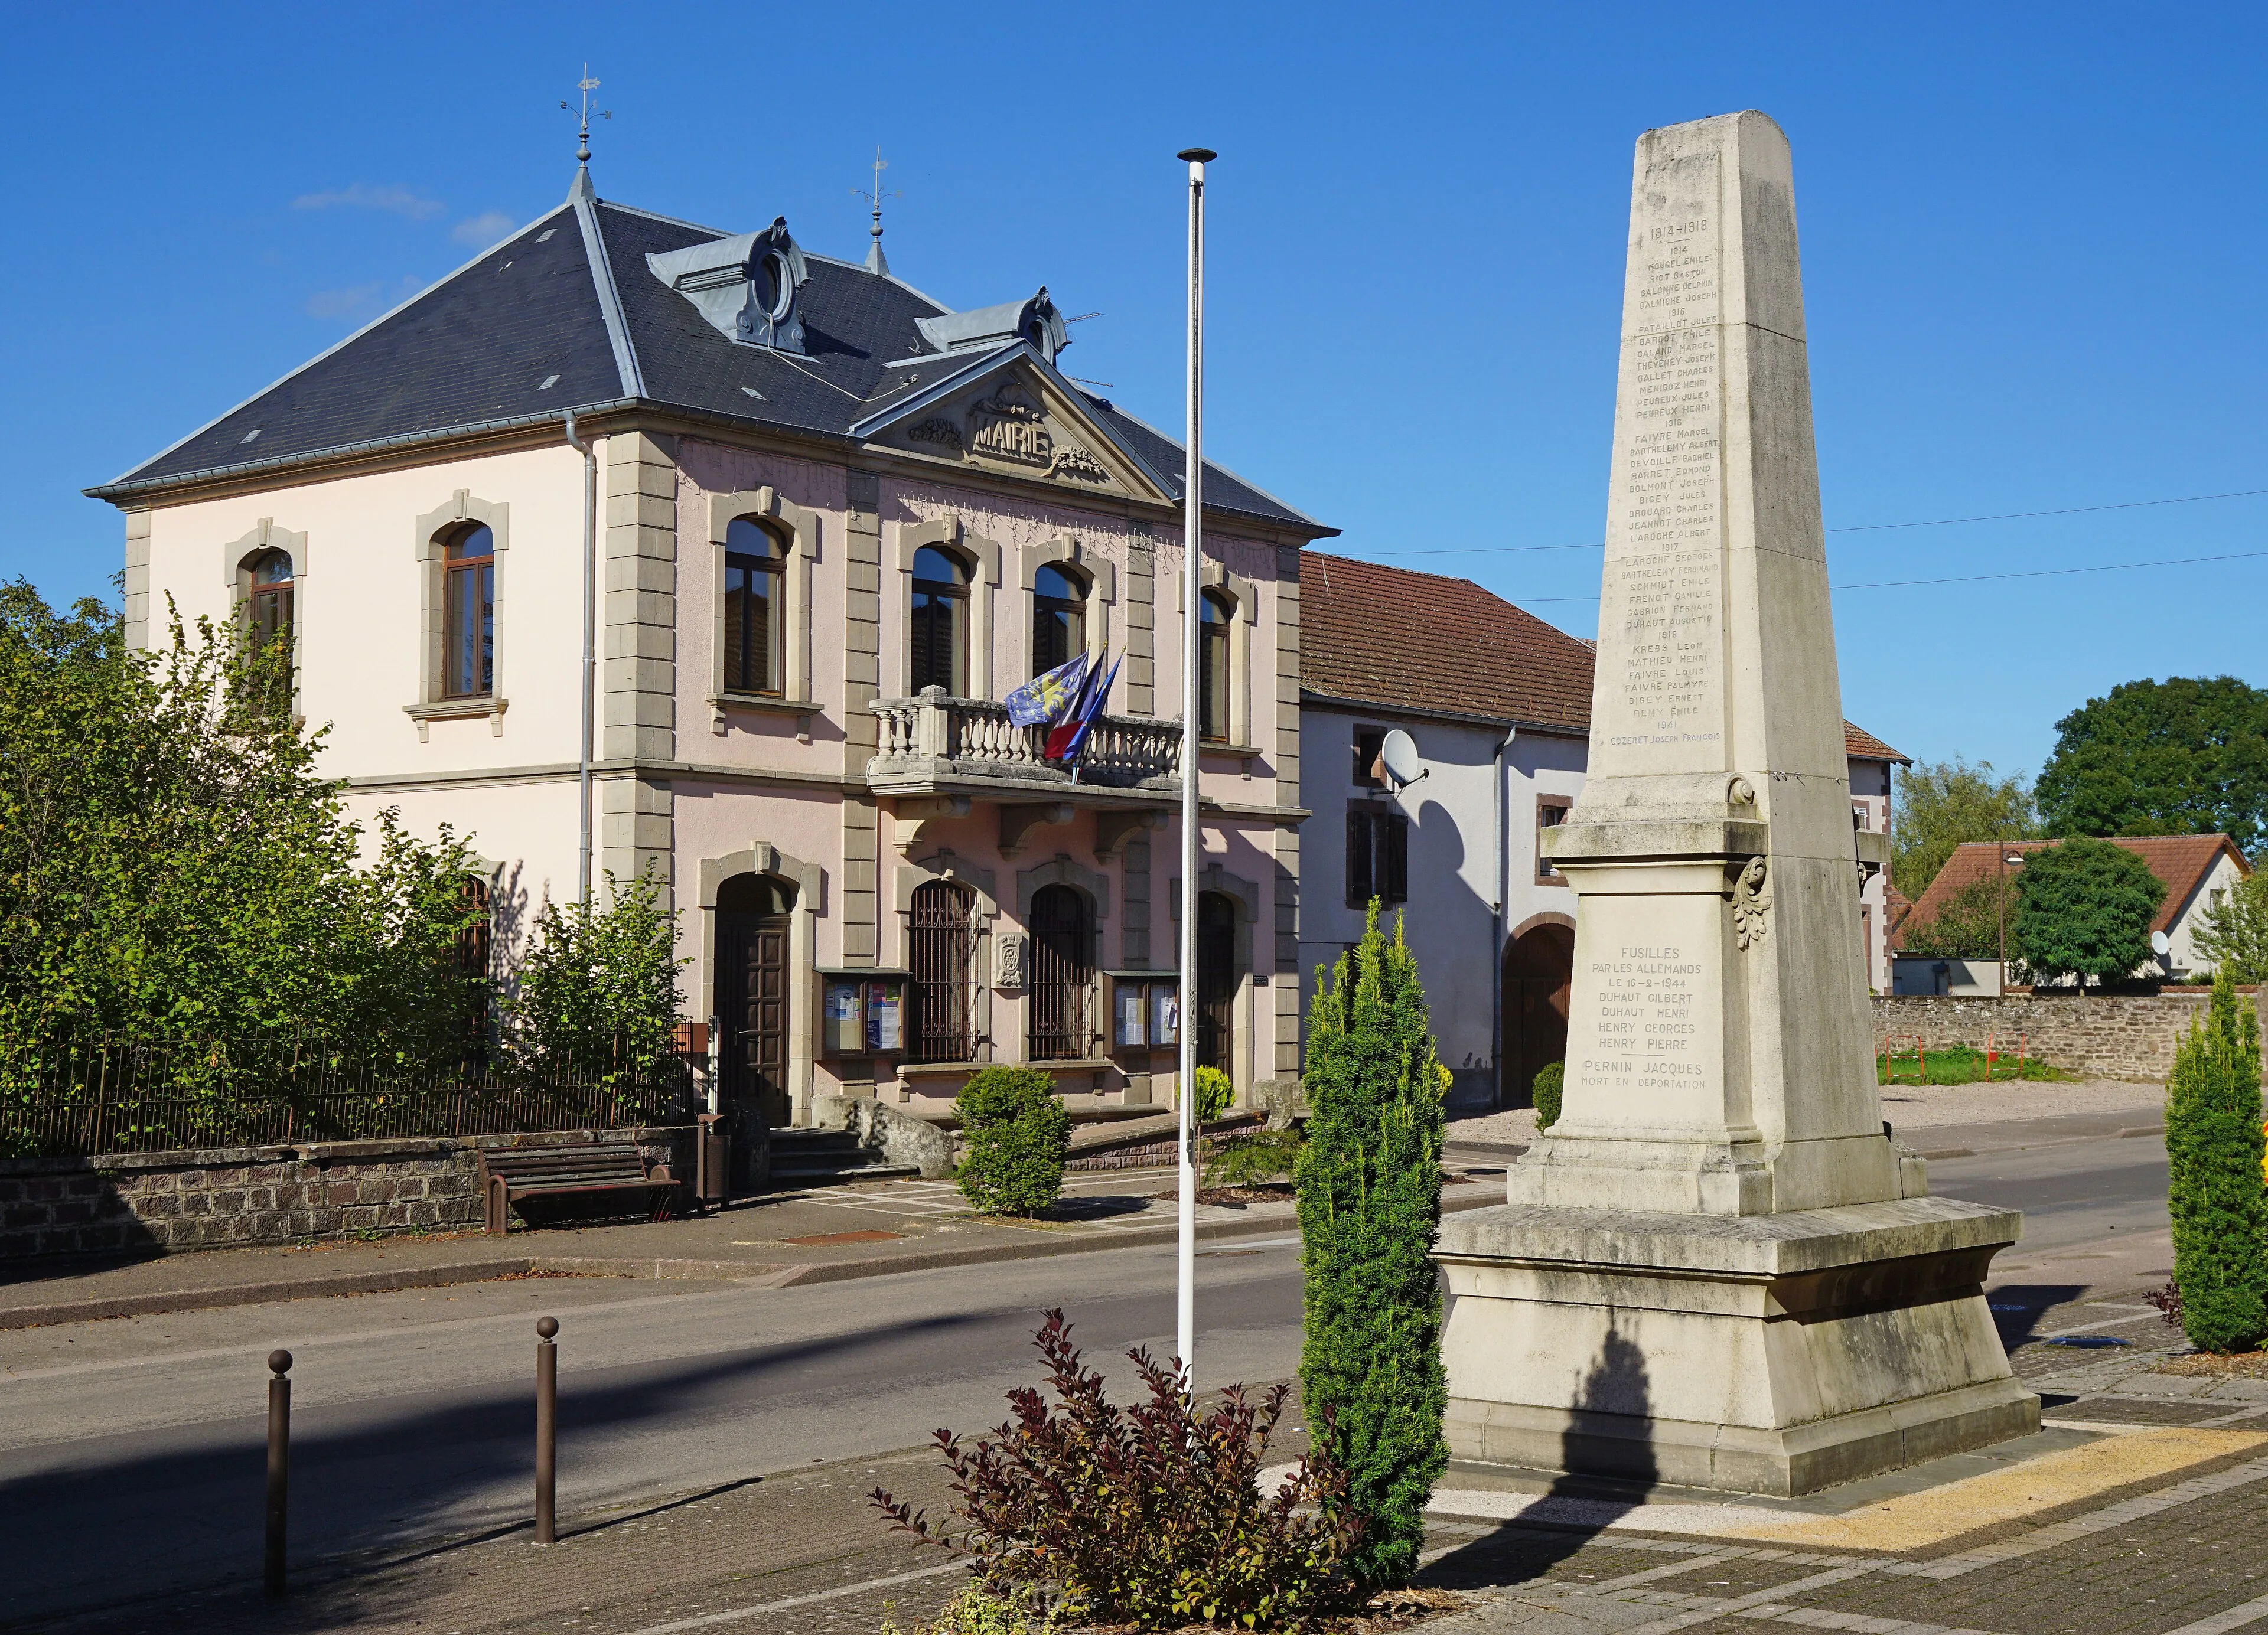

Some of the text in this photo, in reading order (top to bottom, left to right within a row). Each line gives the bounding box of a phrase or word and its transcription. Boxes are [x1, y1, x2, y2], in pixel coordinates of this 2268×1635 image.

[1684, 256, 1709, 265] EMILE
[1683, 280, 1713, 290] DELPHIN
[1686, 291, 1716, 301] JOSEPH
[1639, 316, 1716, 333] PATAILLOT JULES
[1683, 329, 1710, 340] EMILE
[1679, 341, 1715, 353] MARCEL
[1685, 354, 1715, 363] JOSEPH
[1637, 366, 1713, 383] GALLET CHARLES
[1684, 379, 1707, 389] HENRI
[1637, 391, 1709, 407] PEUREUX JULES
[1637, 404, 1710, 419] PEUREUX HENRI
[975, 420, 1048, 458] MAIRIE
[1635, 428, 1711, 443] FAIVRE MARCEL
[1630, 440, 1718, 456] BARTHELEMY ALBERT
[1631, 453, 1715, 468] DEVOILLE GABRIEL
[1631, 465, 1710, 481] BARRET EDMOND
[1630, 478, 1714, 494] BOLMONT JOSEPH
[1640, 491, 1705, 504] BIGEY JULES
[1629, 503, 1713, 518] DROUARD CHARLES
[1629, 515, 1713, 530] JEANNOT CHARLES
[1631, 529, 1711, 543] LAROCHE ALBERT
[1662, 543, 1679, 551] 1917
[1625, 552, 1713, 567] LAROCHE GEORGES
[1621, 564, 1718, 579] BARTHELEMY FERDINAND
[1630, 578, 1710, 591] SCHMIDT EMILE
[1630, 590, 1711, 605] FRENOT CAMILLE
[1627, 603, 1713, 616] GABRION FERNAND
[1627, 615, 1712, 629] DUHAUT AUGUSTIN
[1659, 631, 1677, 640] 1918
[1633, 642, 1702, 655] KREBS LEON
[1628, 655, 1707, 668] MATHIEU HENRI
[1629, 668, 1704, 680] FAIVRE LOUIS
[1625, 681, 1709, 692] FAIVRE PALMYRE
[1629, 694, 1704, 705] BIGEY ERNEST
[1634, 708, 1664, 717] REMY
[1658, 720, 1677, 729] 1941
[1611, 733, 1720, 745] COZERET JOSEPH FRANCOIS
[1621, 947, 1679, 960] FUSILLES
[1592, 963, 1702, 974] PAR LES ALLEMANDS
[1599, 993, 1693, 1004] DUHAUT GILBERT
[1602, 1007, 1689, 1019] DUHAUT HENRI
[1599, 1022, 1695, 1034] HENRY GEORGES
[1599, 1038, 1687, 1050] HENRY PIERRE
[1585, 1060, 1702, 1077] PERNIN JACQUES
[1582, 1077, 1705, 1089] MORT EN DEPORTATION
